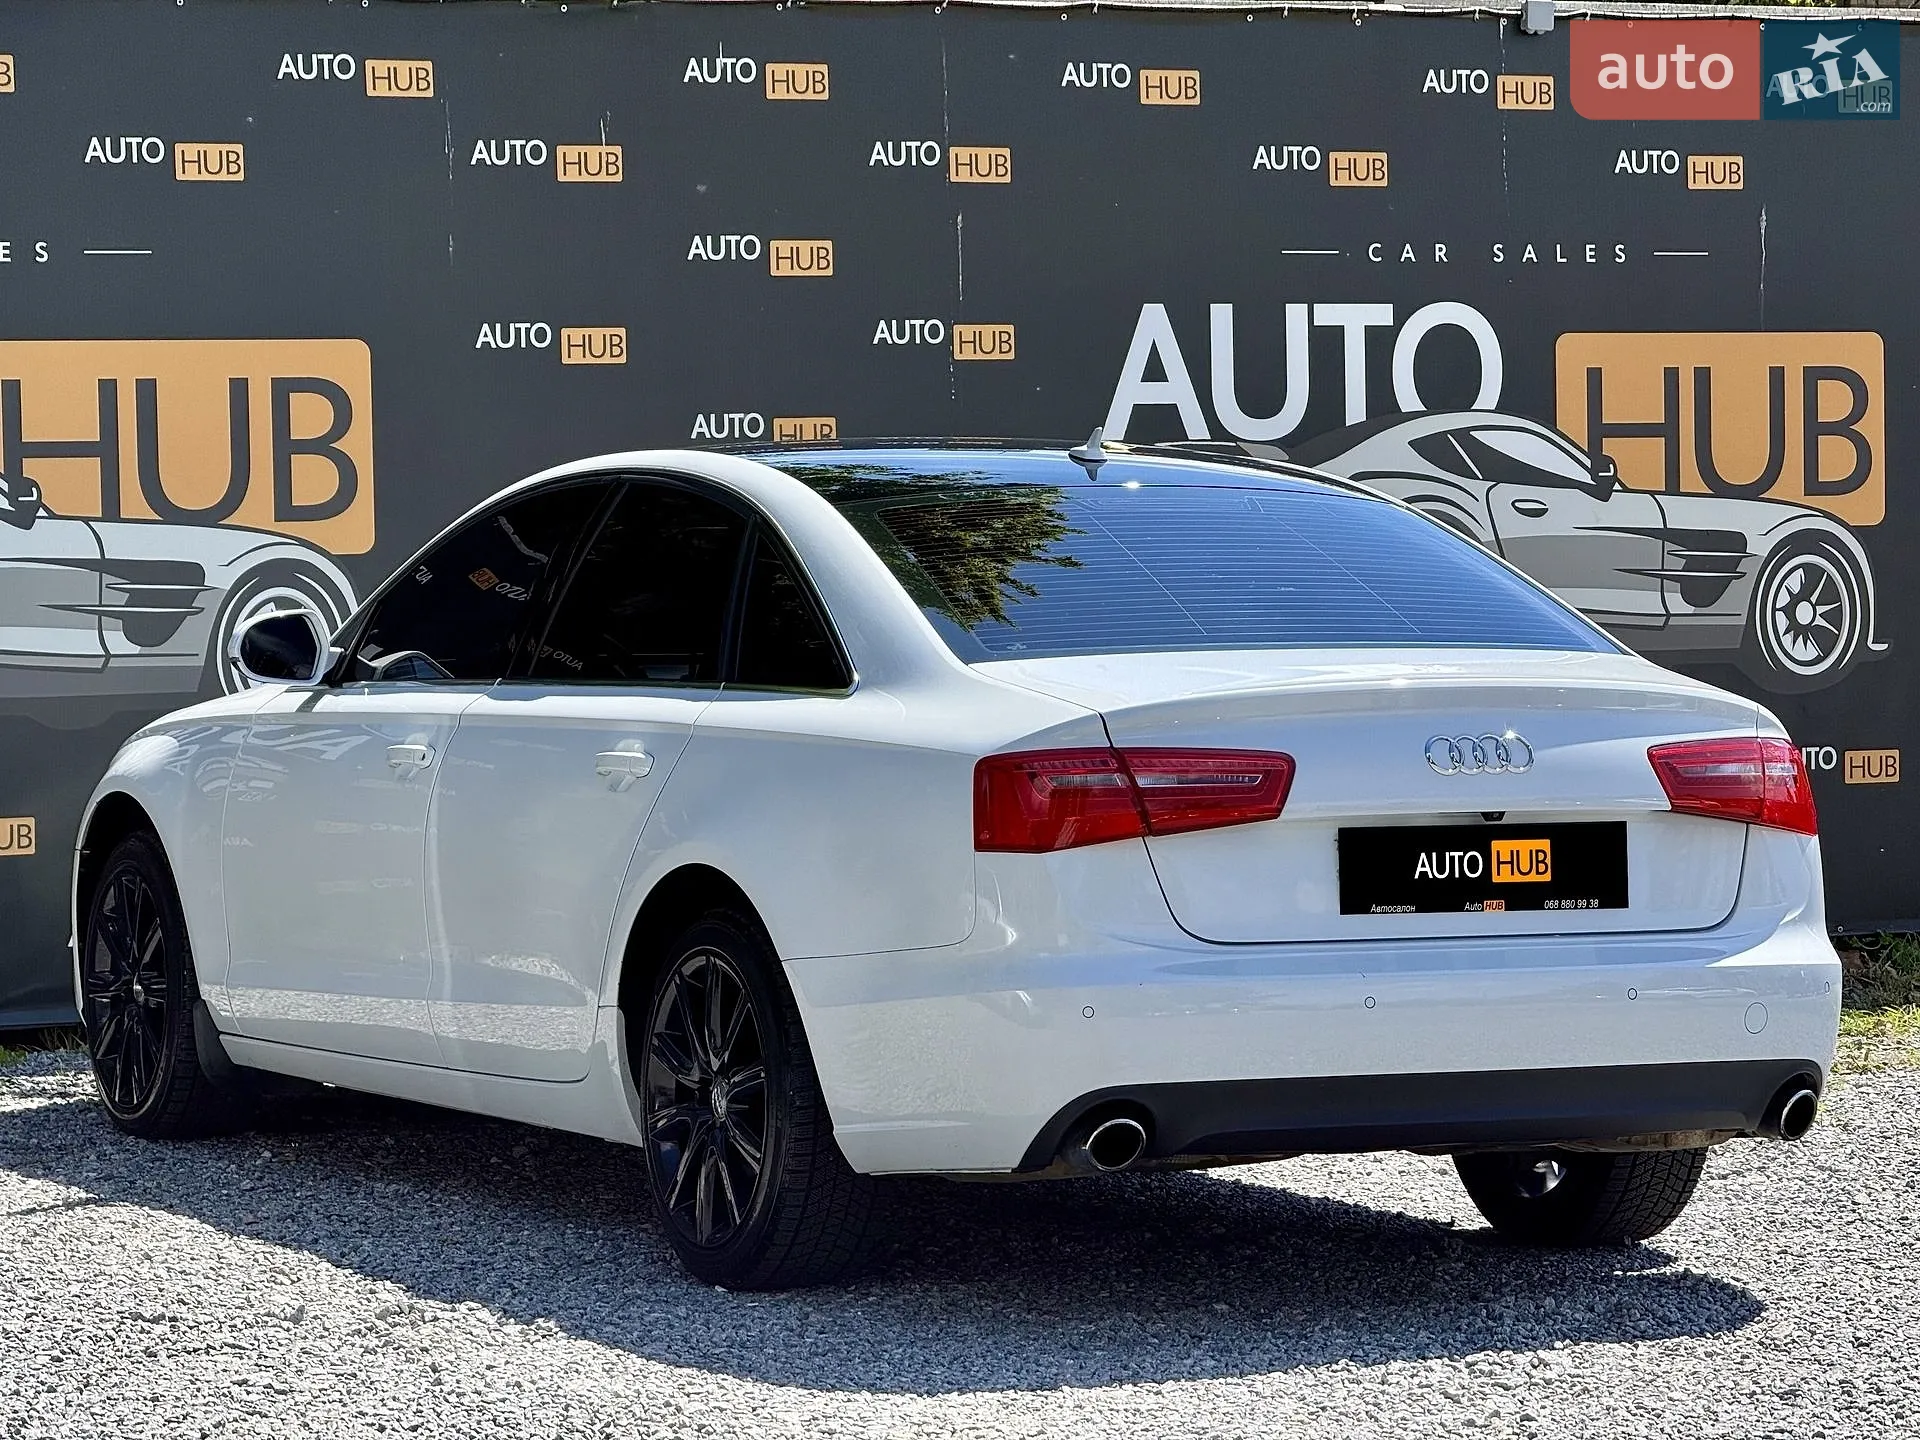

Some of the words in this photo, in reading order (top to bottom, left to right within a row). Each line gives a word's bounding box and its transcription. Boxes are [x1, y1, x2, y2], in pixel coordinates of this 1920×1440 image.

[278, 54, 356, 80] AUTO
[371, 66, 431, 92] HUB
[684, 58, 756, 83] AUTO
[771, 70, 827, 94] HUB
[1062, 63, 1131, 88] AUTO
[1145, 76, 1198, 99] HUB
[1423, 69, 1488, 93] AUTO
[1502, 81, 1552, 105] HUB
[85, 137, 164, 163] AUTO
[181, 150, 242, 175] HUB
[471, 140, 547, 165] AUTO
[562, 152, 620, 177] HUB
[869, 141, 941, 166] AUTO
[954, 153, 1009, 178] HUB
[1253, 146, 1320, 170] AUTO
[1334, 158, 1386, 182] HUB
[1615, 150, 1679, 174] AUTO
[1692, 162, 1741, 185] HUB
[688, 235, 760, 260] AUTO
[775, 247, 831, 271] HUB
[1369, 243, 1448, 262] CAR
[1494, 243, 1626, 263] SALES
[476, 323, 551, 348] AUTO
[566, 334, 624, 358] HUB
[873, 319, 944, 344] AUTO
[958, 331, 1013, 355] HUB
[1104, 302, 1503, 441] AUTO
[1586, 365, 1872, 496] HUB
[691, 412, 764, 439] AUTO
[1, 377, 358, 525] HUB
[1801, 746, 1837, 770] TO
[1849, 755, 1897, 779] HUB
[0, 824, 32, 851] UB
[1415, 851, 1482, 879] AUTO
[1496, 849, 1549, 877] HUB
[1370, 903, 1416, 913] Автосалон
[1464, 901, 1483, 911] Auto
[1484, 901, 1504, 911] HUB
[1544, 899, 1559, 909] 068
[1560, 899, 1575, 909] 880
[1577, 899, 1587, 908] 99
[1588, 898, 1599, 908] 38
